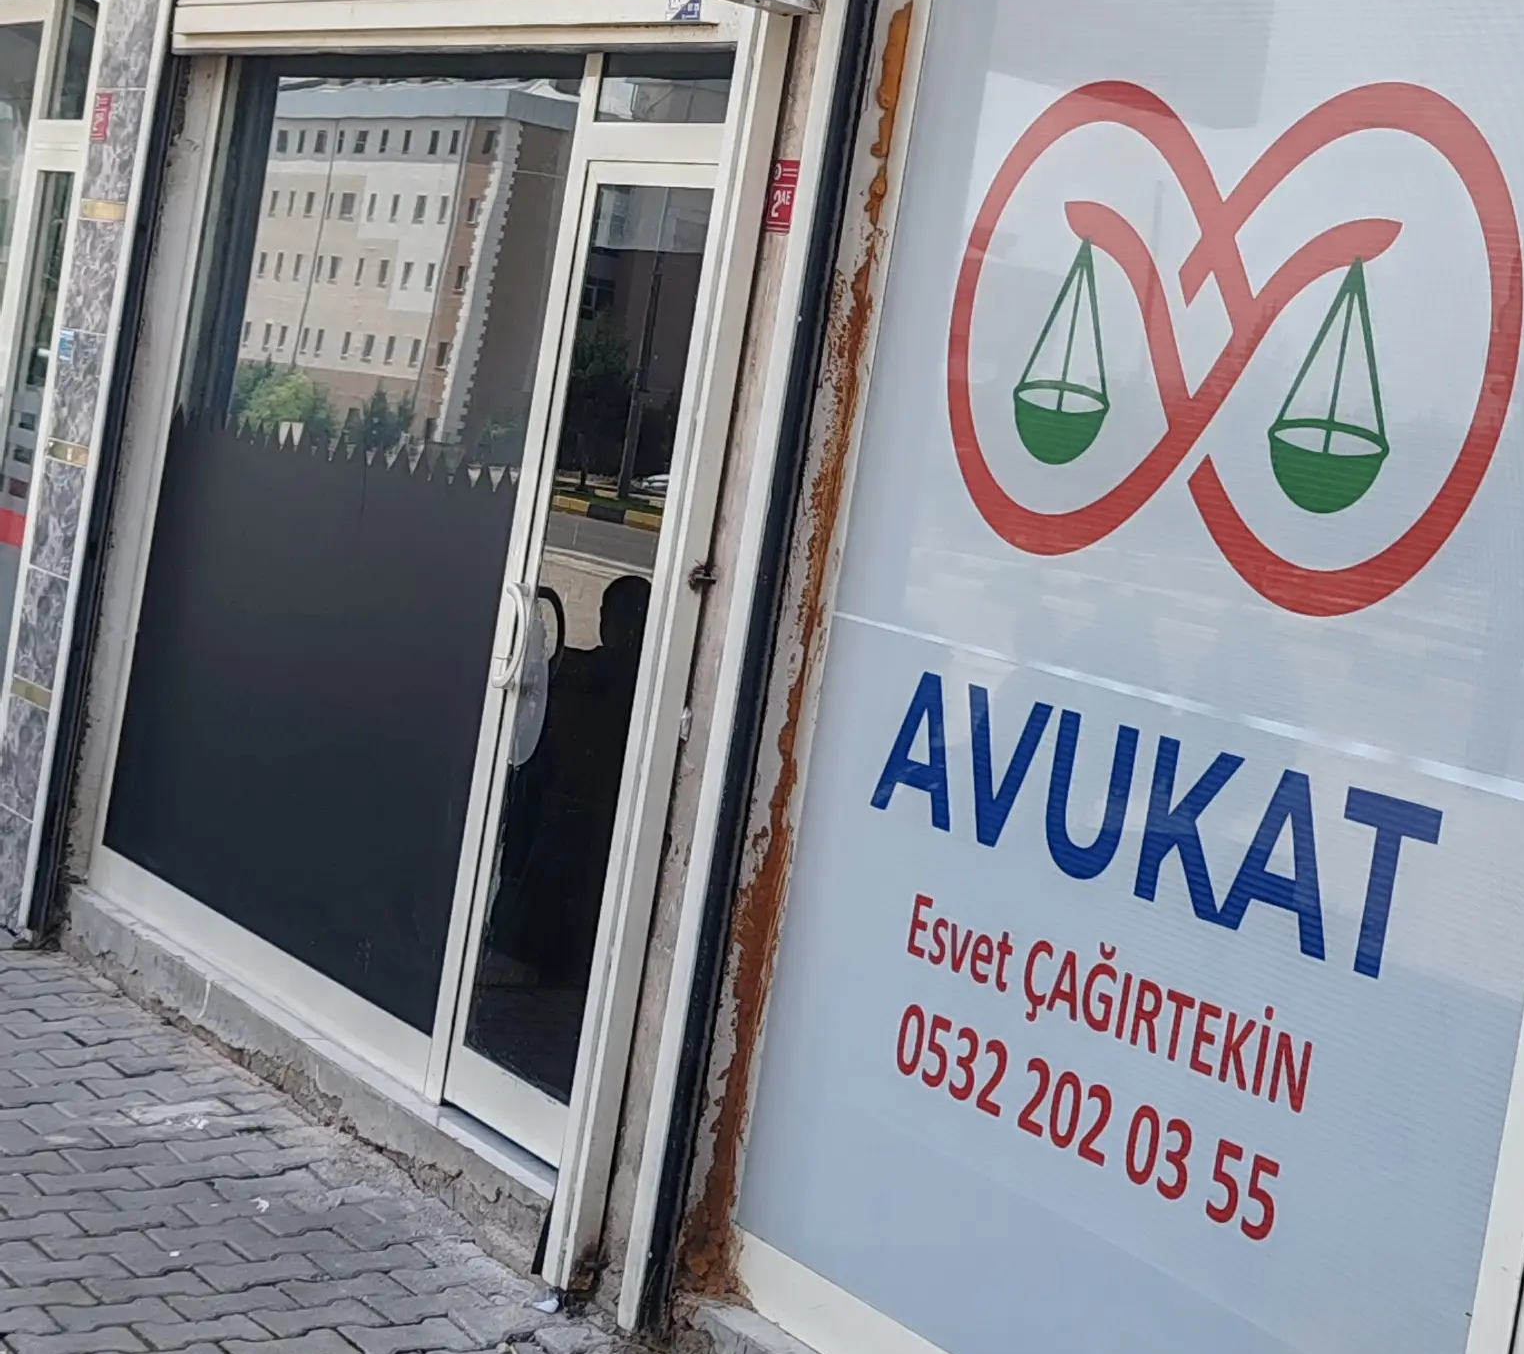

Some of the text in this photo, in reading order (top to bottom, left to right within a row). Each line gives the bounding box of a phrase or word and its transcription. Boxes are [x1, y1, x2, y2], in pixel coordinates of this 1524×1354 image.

[870, 670, 1443, 980] AVUKAT
[896, 1003, 1280, 1241] 0532 202 03 55
[906, 893, 1313, 1114] Esvet ÇAĞIRTEKİN
